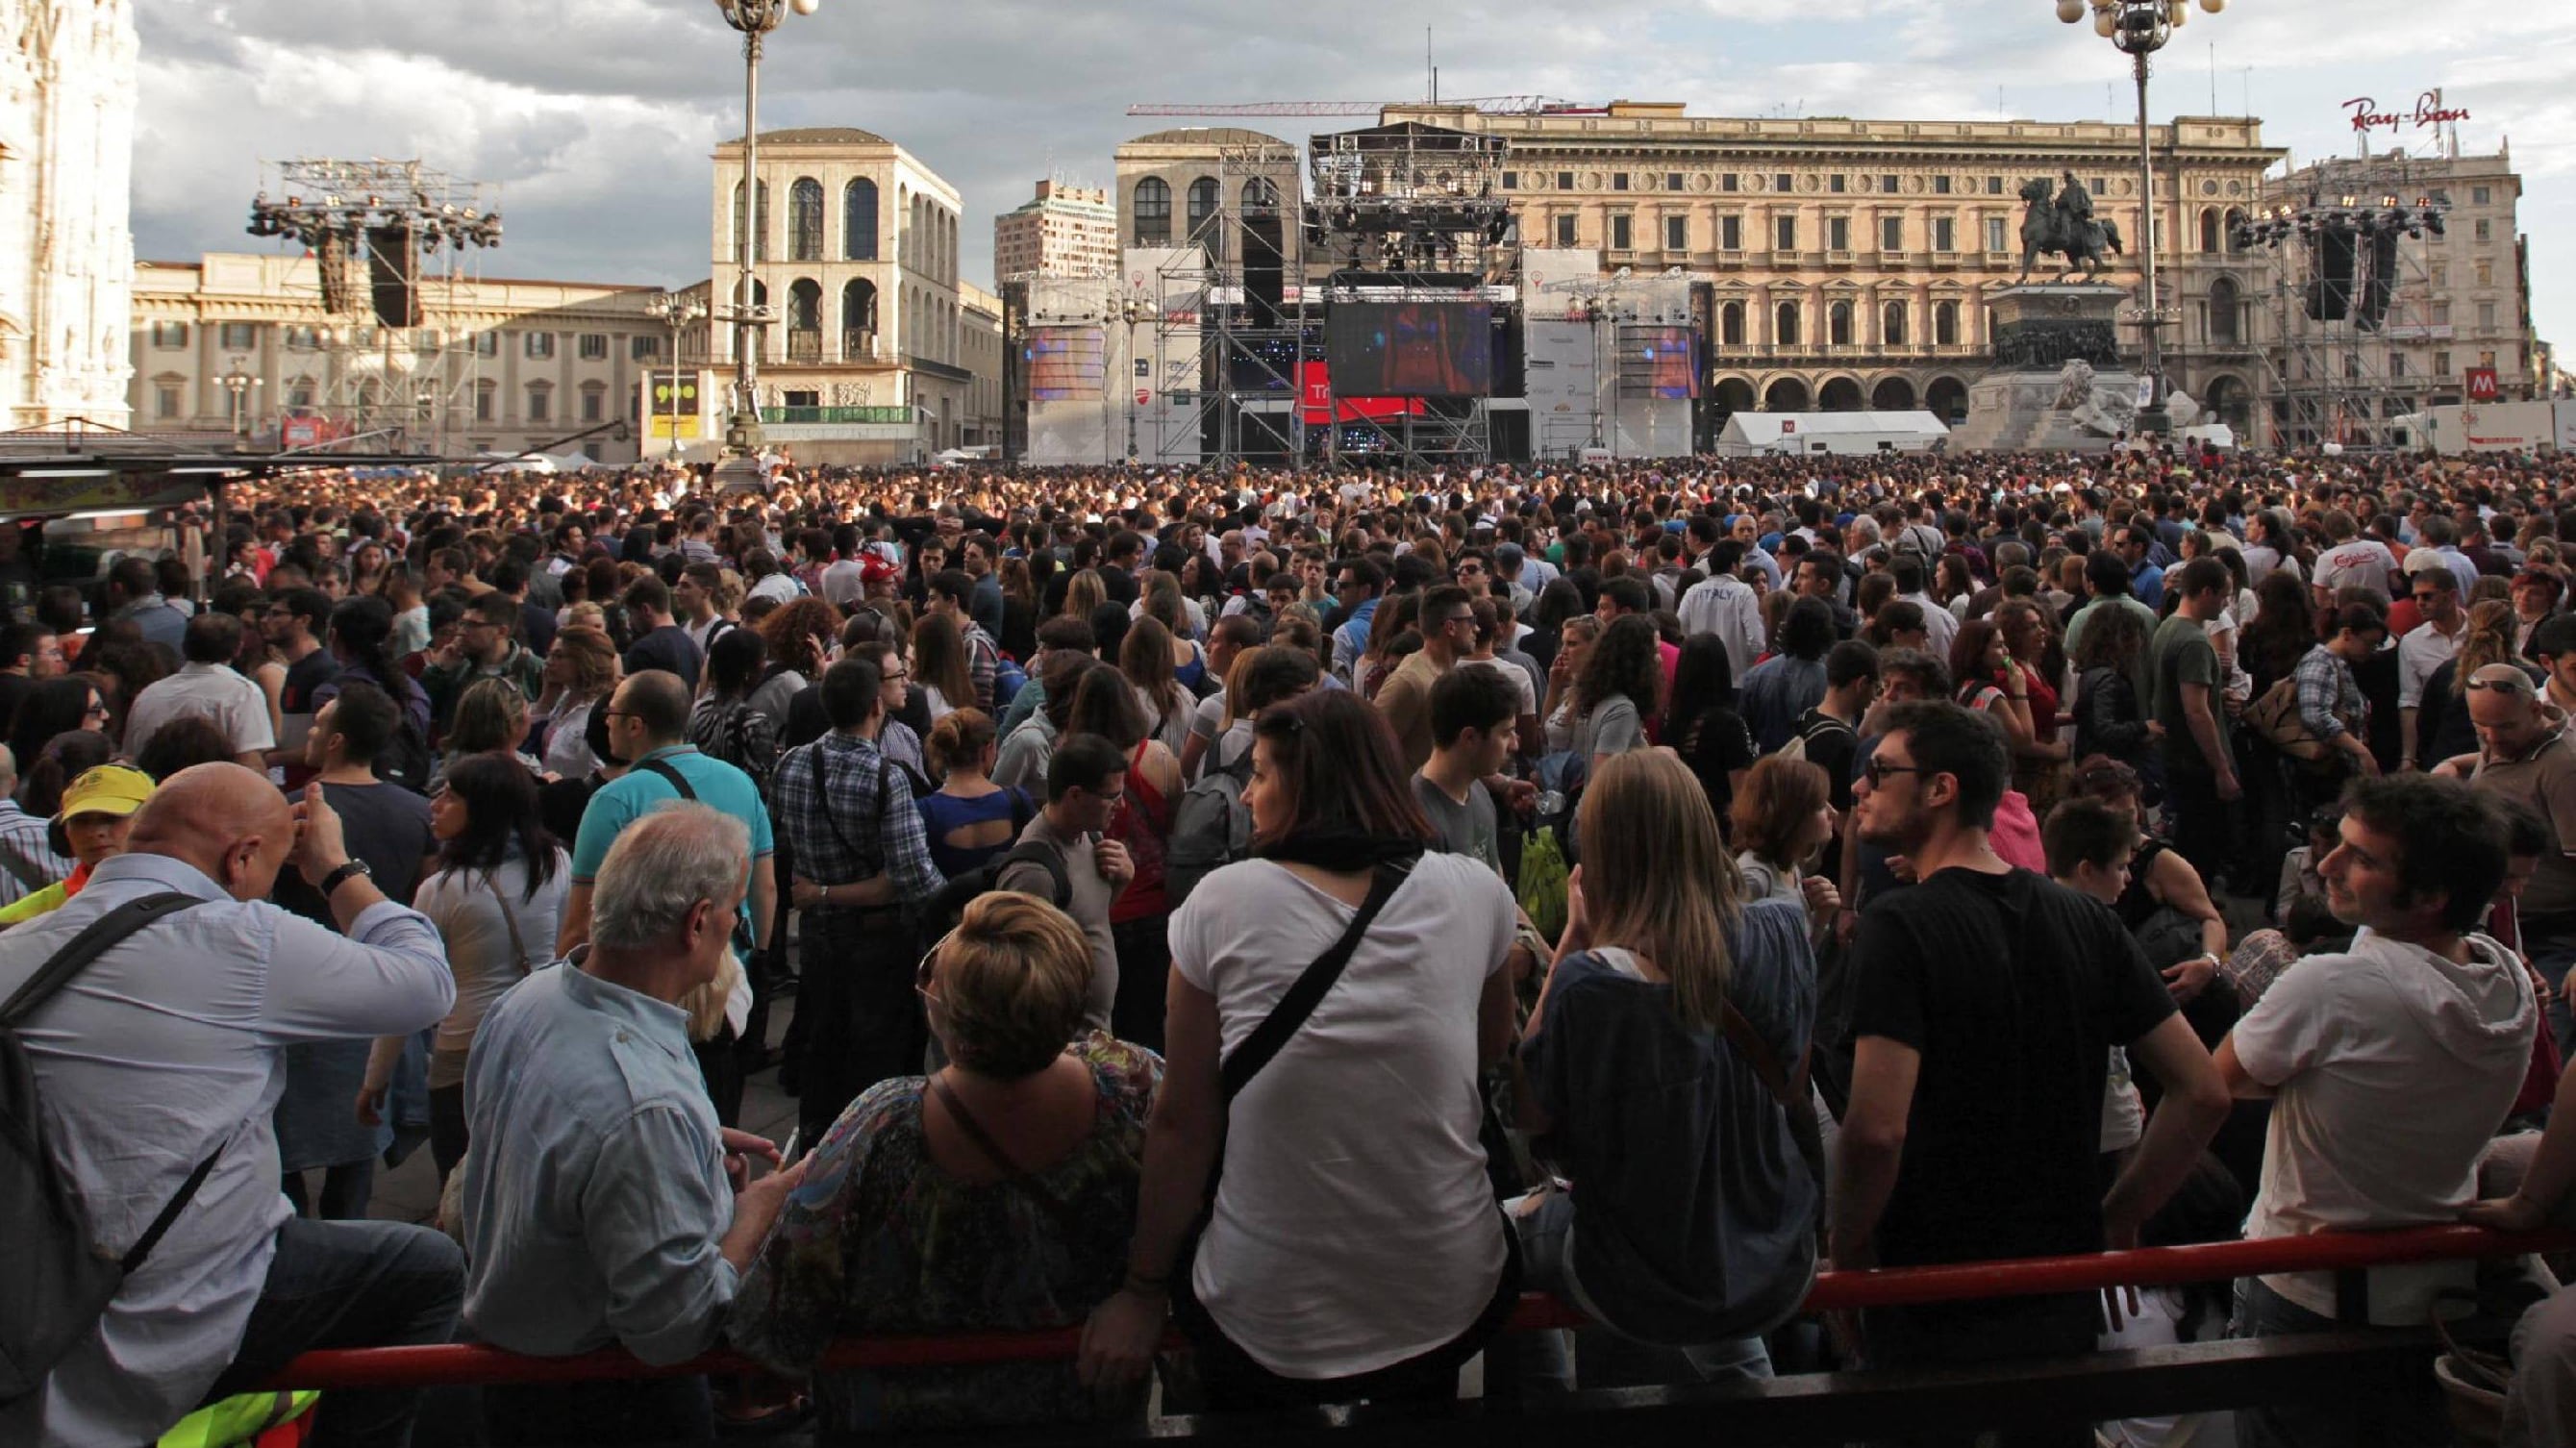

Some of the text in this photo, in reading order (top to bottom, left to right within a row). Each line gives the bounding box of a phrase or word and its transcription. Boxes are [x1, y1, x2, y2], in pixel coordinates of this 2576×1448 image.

[2341, 92, 2470, 133] Ray-Ban
[2473, 374, 2495, 392] M
[2334, 549, 2378, 568] Carlsberg
[1699, 587, 1734, 600] ITALY
